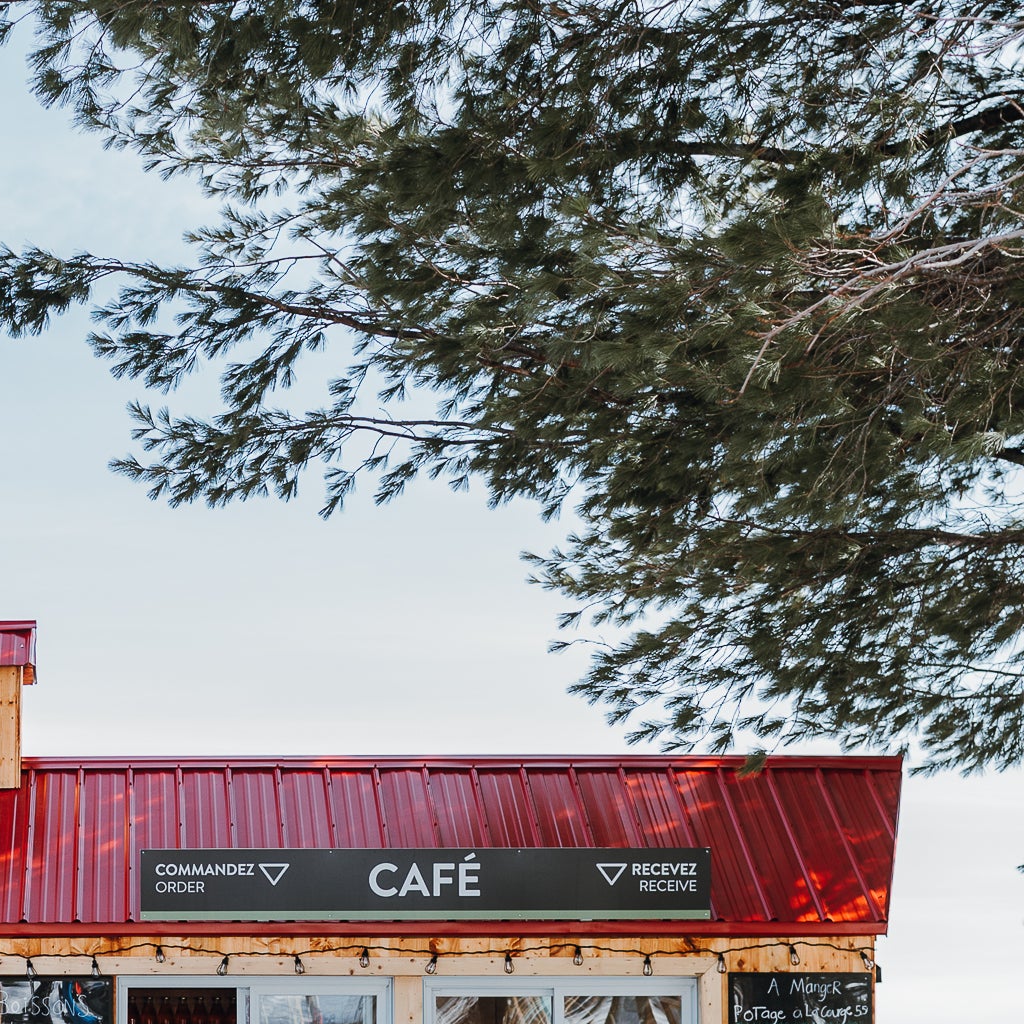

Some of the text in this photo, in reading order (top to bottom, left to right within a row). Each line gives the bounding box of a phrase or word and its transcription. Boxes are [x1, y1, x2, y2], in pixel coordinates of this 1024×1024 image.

[155, 863, 255, 877] COMMANDEZ
[368, 852, 481, 898] CAFÉ
[632, 862, 697, 877] RECEVEZ
[155, 880, 205, 894] ORDER
[639, 879, 697, 893] RECEIVE
